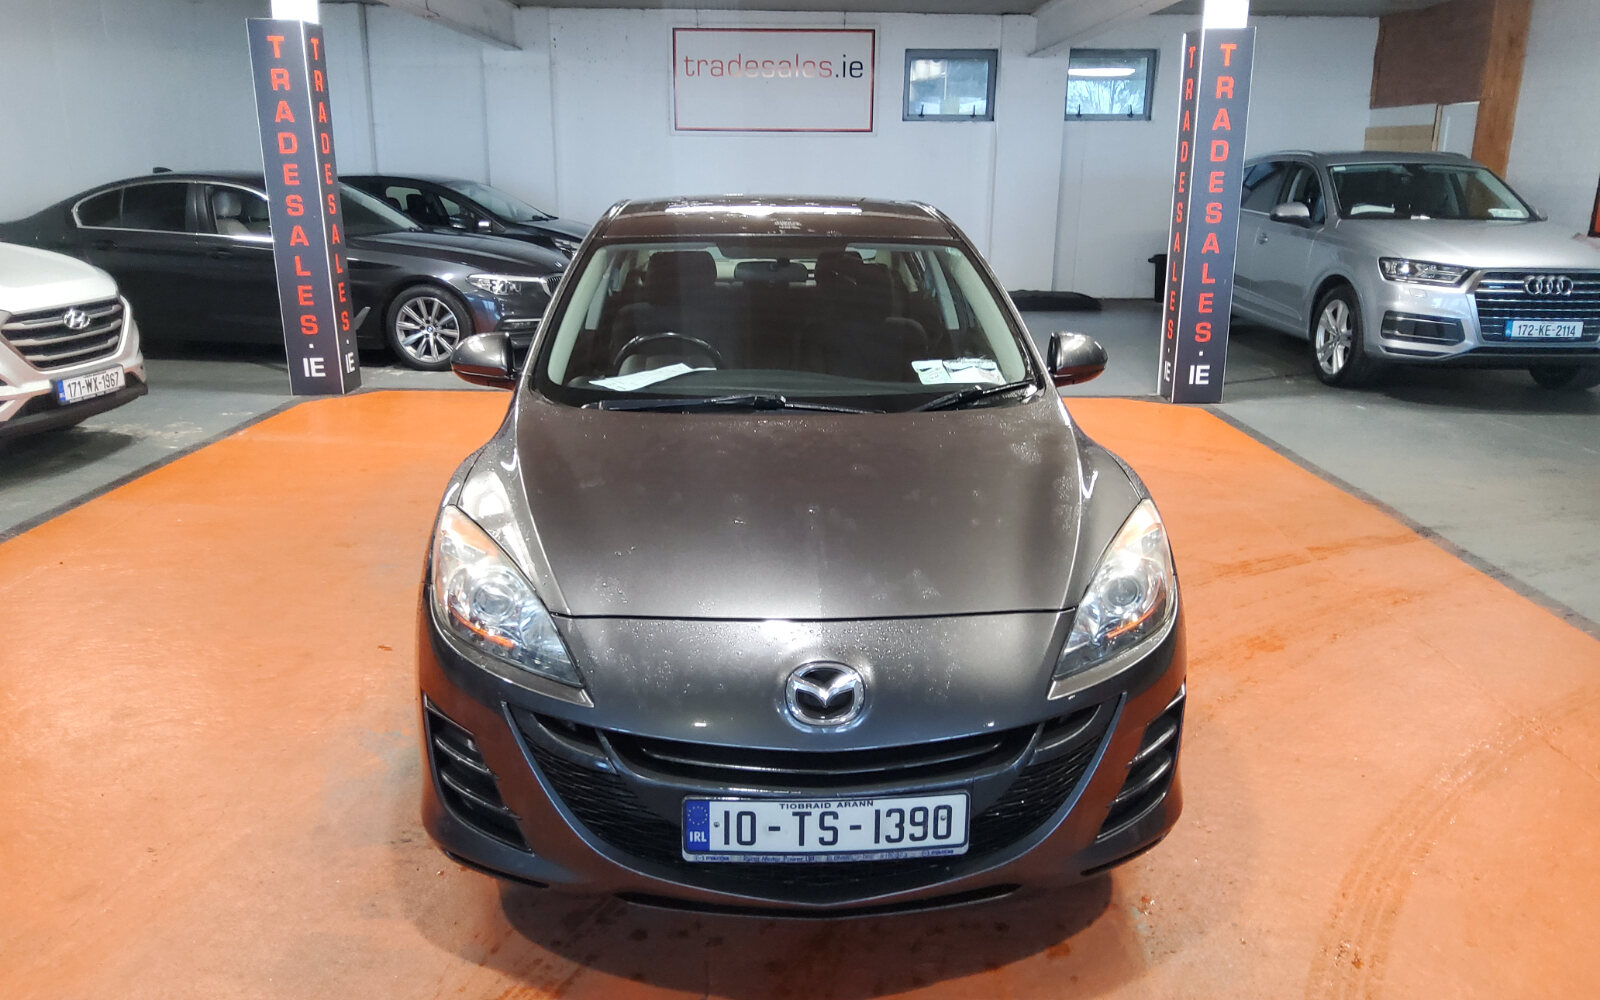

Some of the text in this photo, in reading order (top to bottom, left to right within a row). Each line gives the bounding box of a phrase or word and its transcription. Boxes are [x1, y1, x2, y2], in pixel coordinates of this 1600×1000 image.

[684, 53, 864, 78] tradesales.ie
[1518, 324, 1577, 337] 172-KE-2114
[67, 371, 119, 398] 171-WX-1967
[779, 800, 874, 810] TIOBRAID ARANN
[689, 830, 707, 843] IRL
